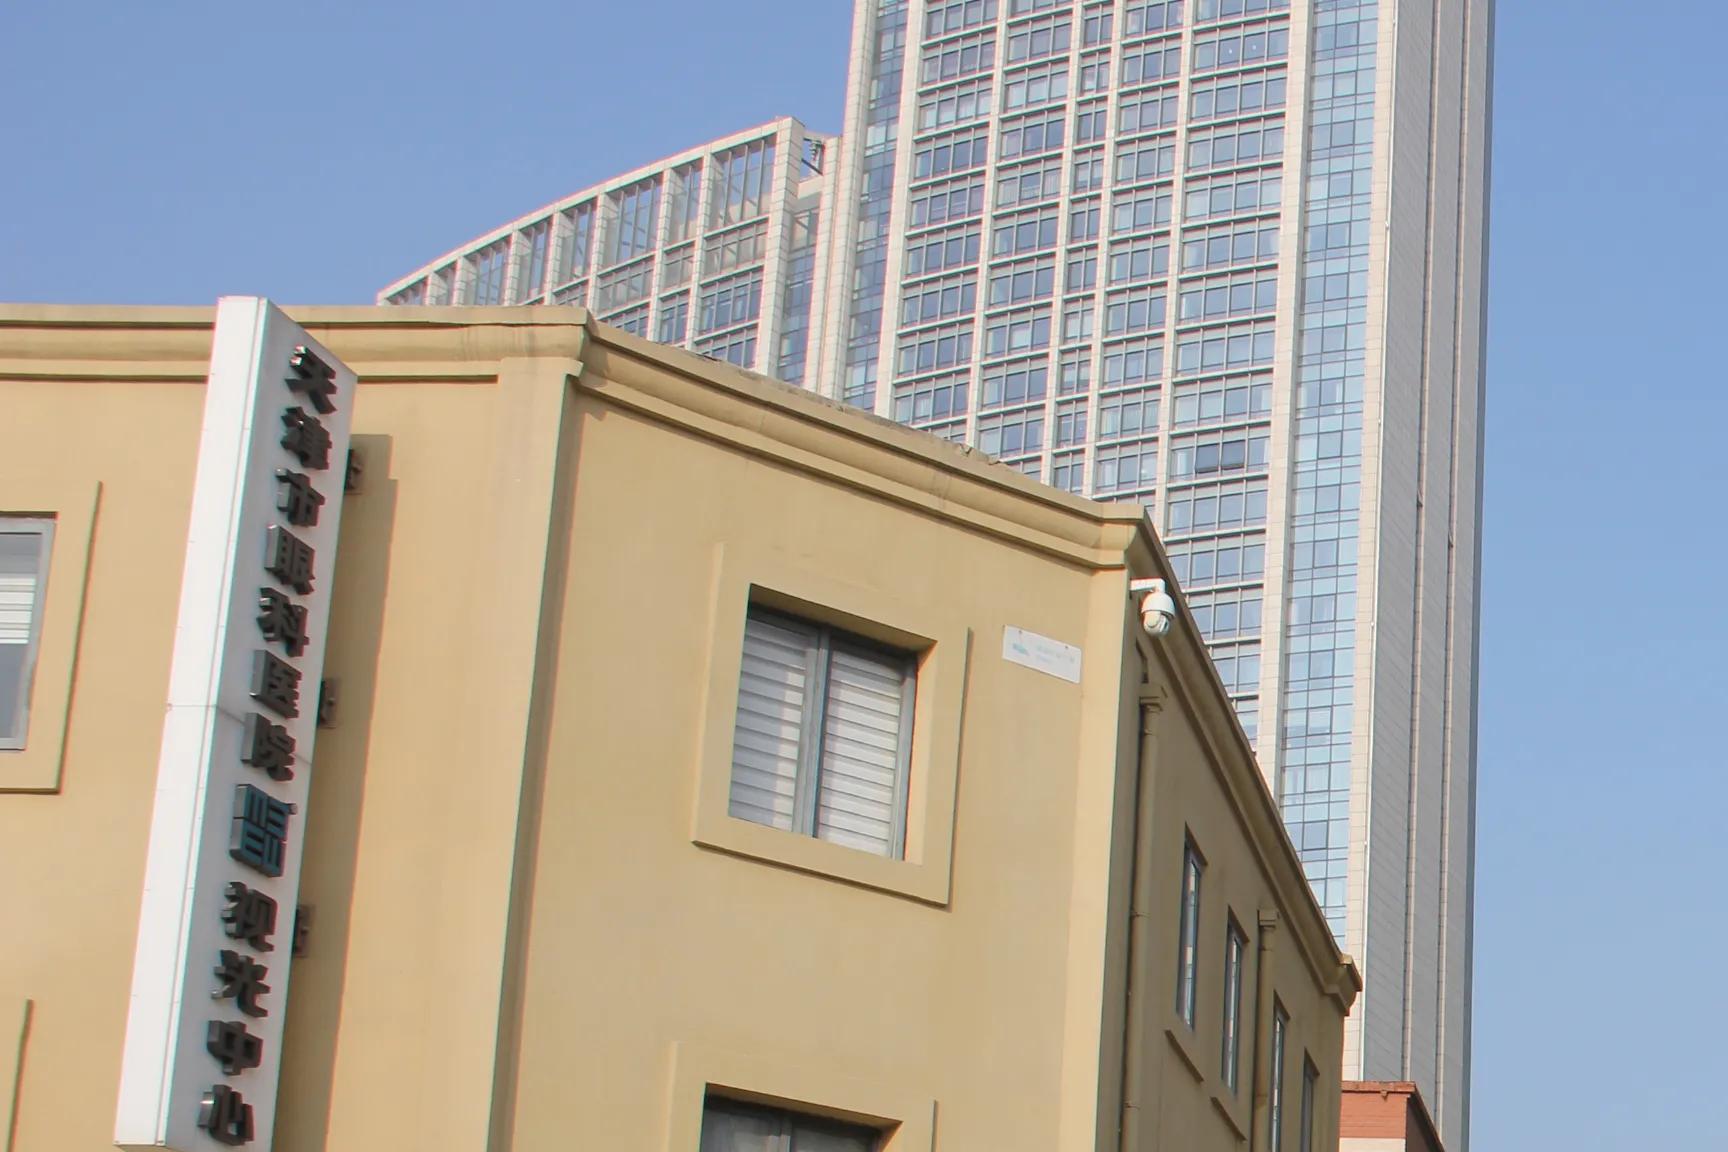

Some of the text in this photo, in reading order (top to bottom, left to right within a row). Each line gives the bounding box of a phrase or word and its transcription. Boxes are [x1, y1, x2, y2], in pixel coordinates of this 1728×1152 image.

[240, 344, 337, 782] 天津市眼科医院
[197, 881, 278, 1147] 视光中心
